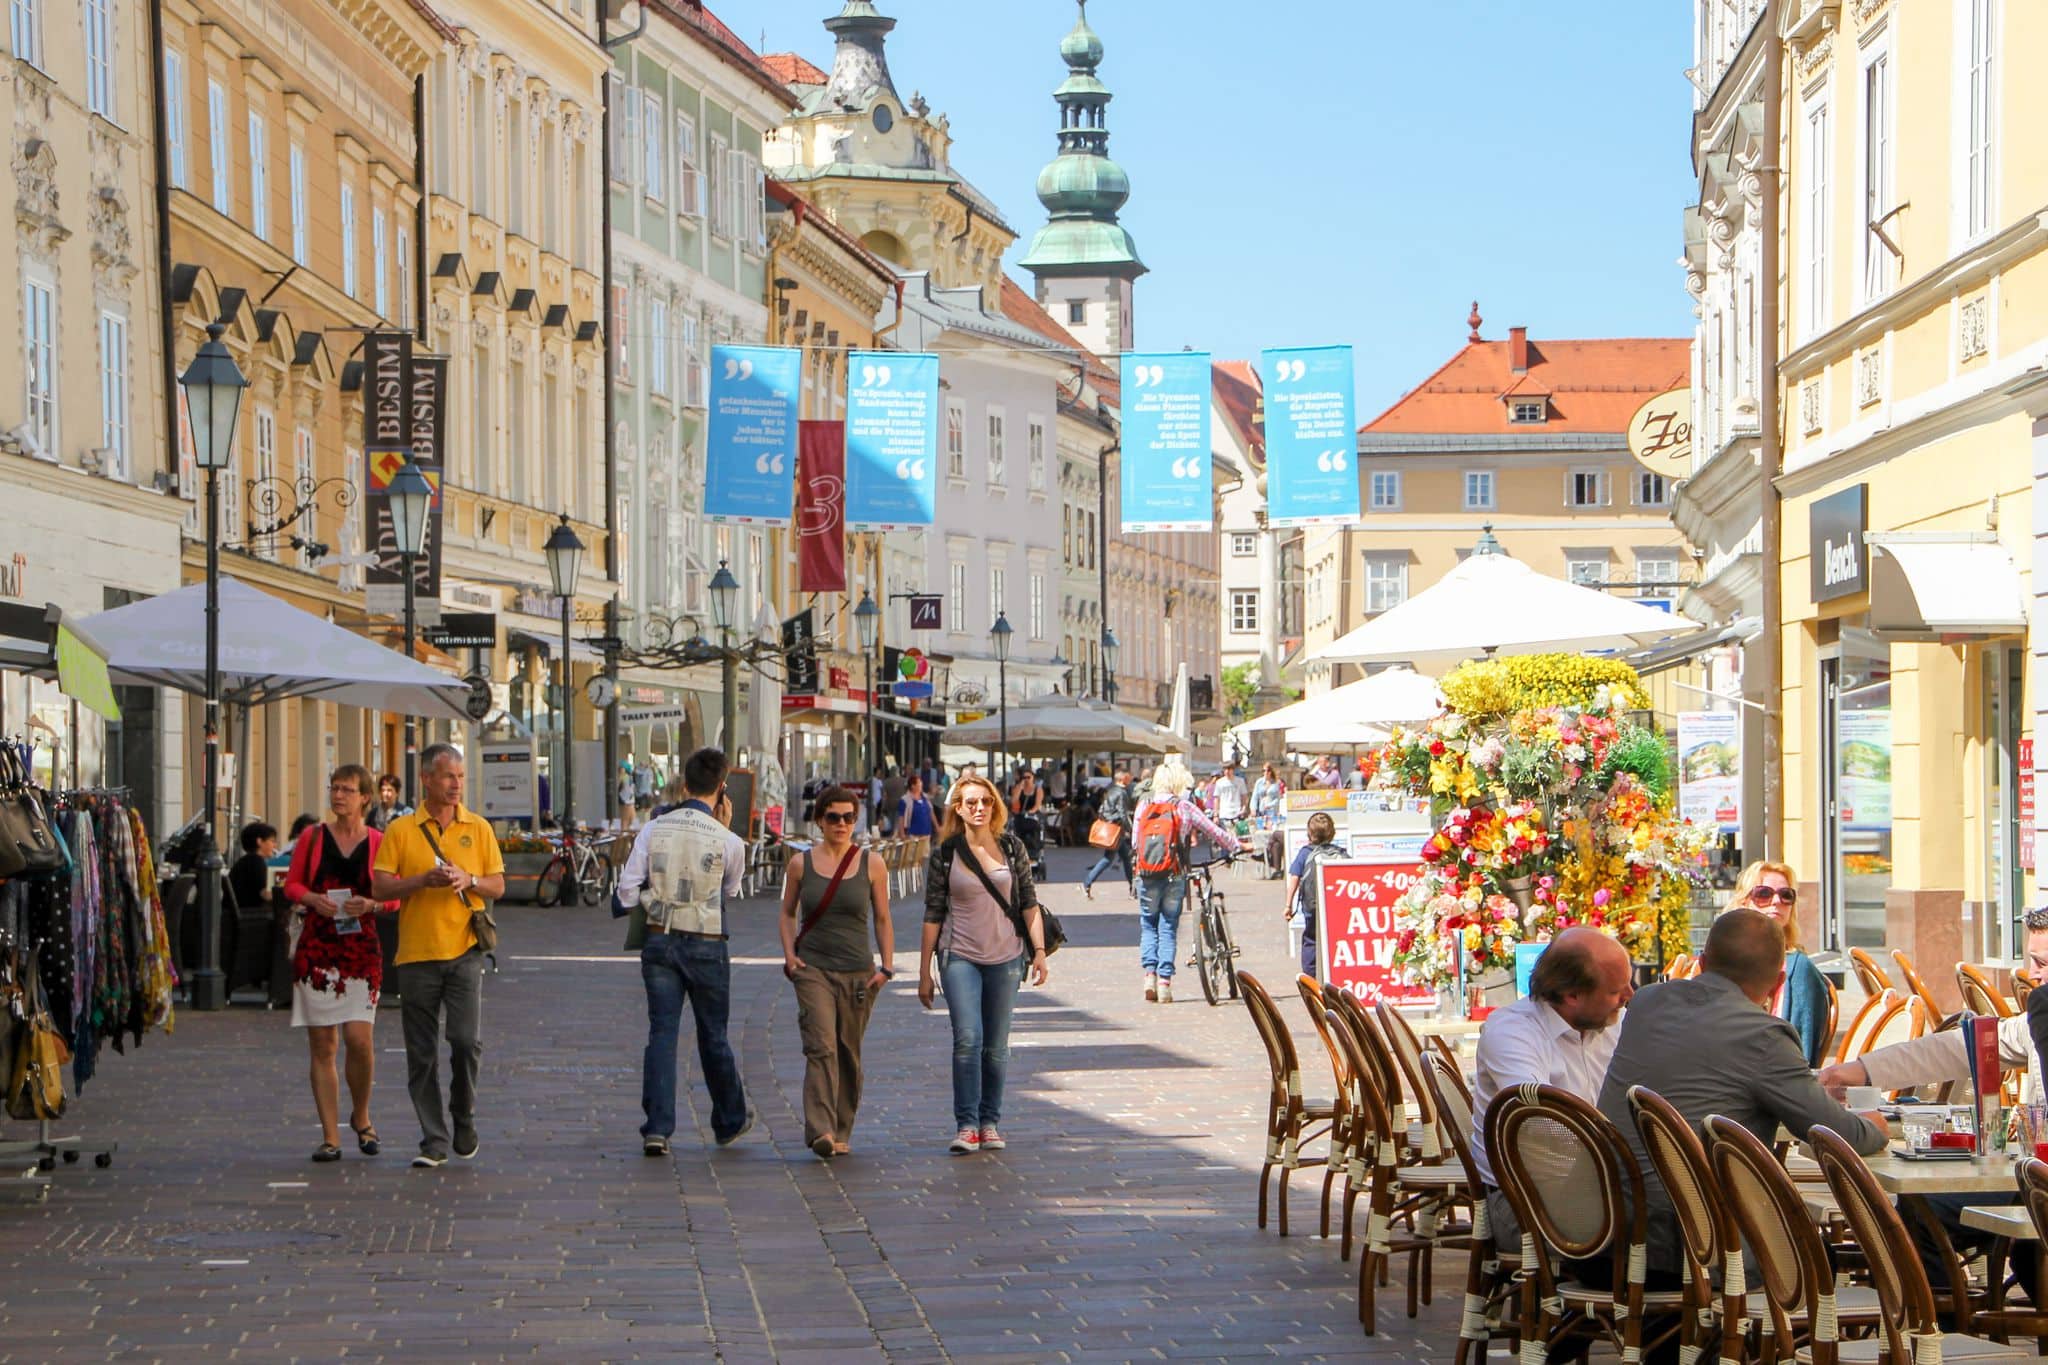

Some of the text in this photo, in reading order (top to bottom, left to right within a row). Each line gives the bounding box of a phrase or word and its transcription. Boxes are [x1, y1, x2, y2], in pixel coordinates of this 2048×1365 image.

[377, 341, 401, 440] BESIM
[412, 365, 436, 460] BESIM
[801, 475, 842, 536] 3
[1824, 531, 1858, 586] Bench.
[915, 602, 936, 623] M
[434, 635, 495, 646] intimissimi
[1325, 879, 1377, 902] -70%
